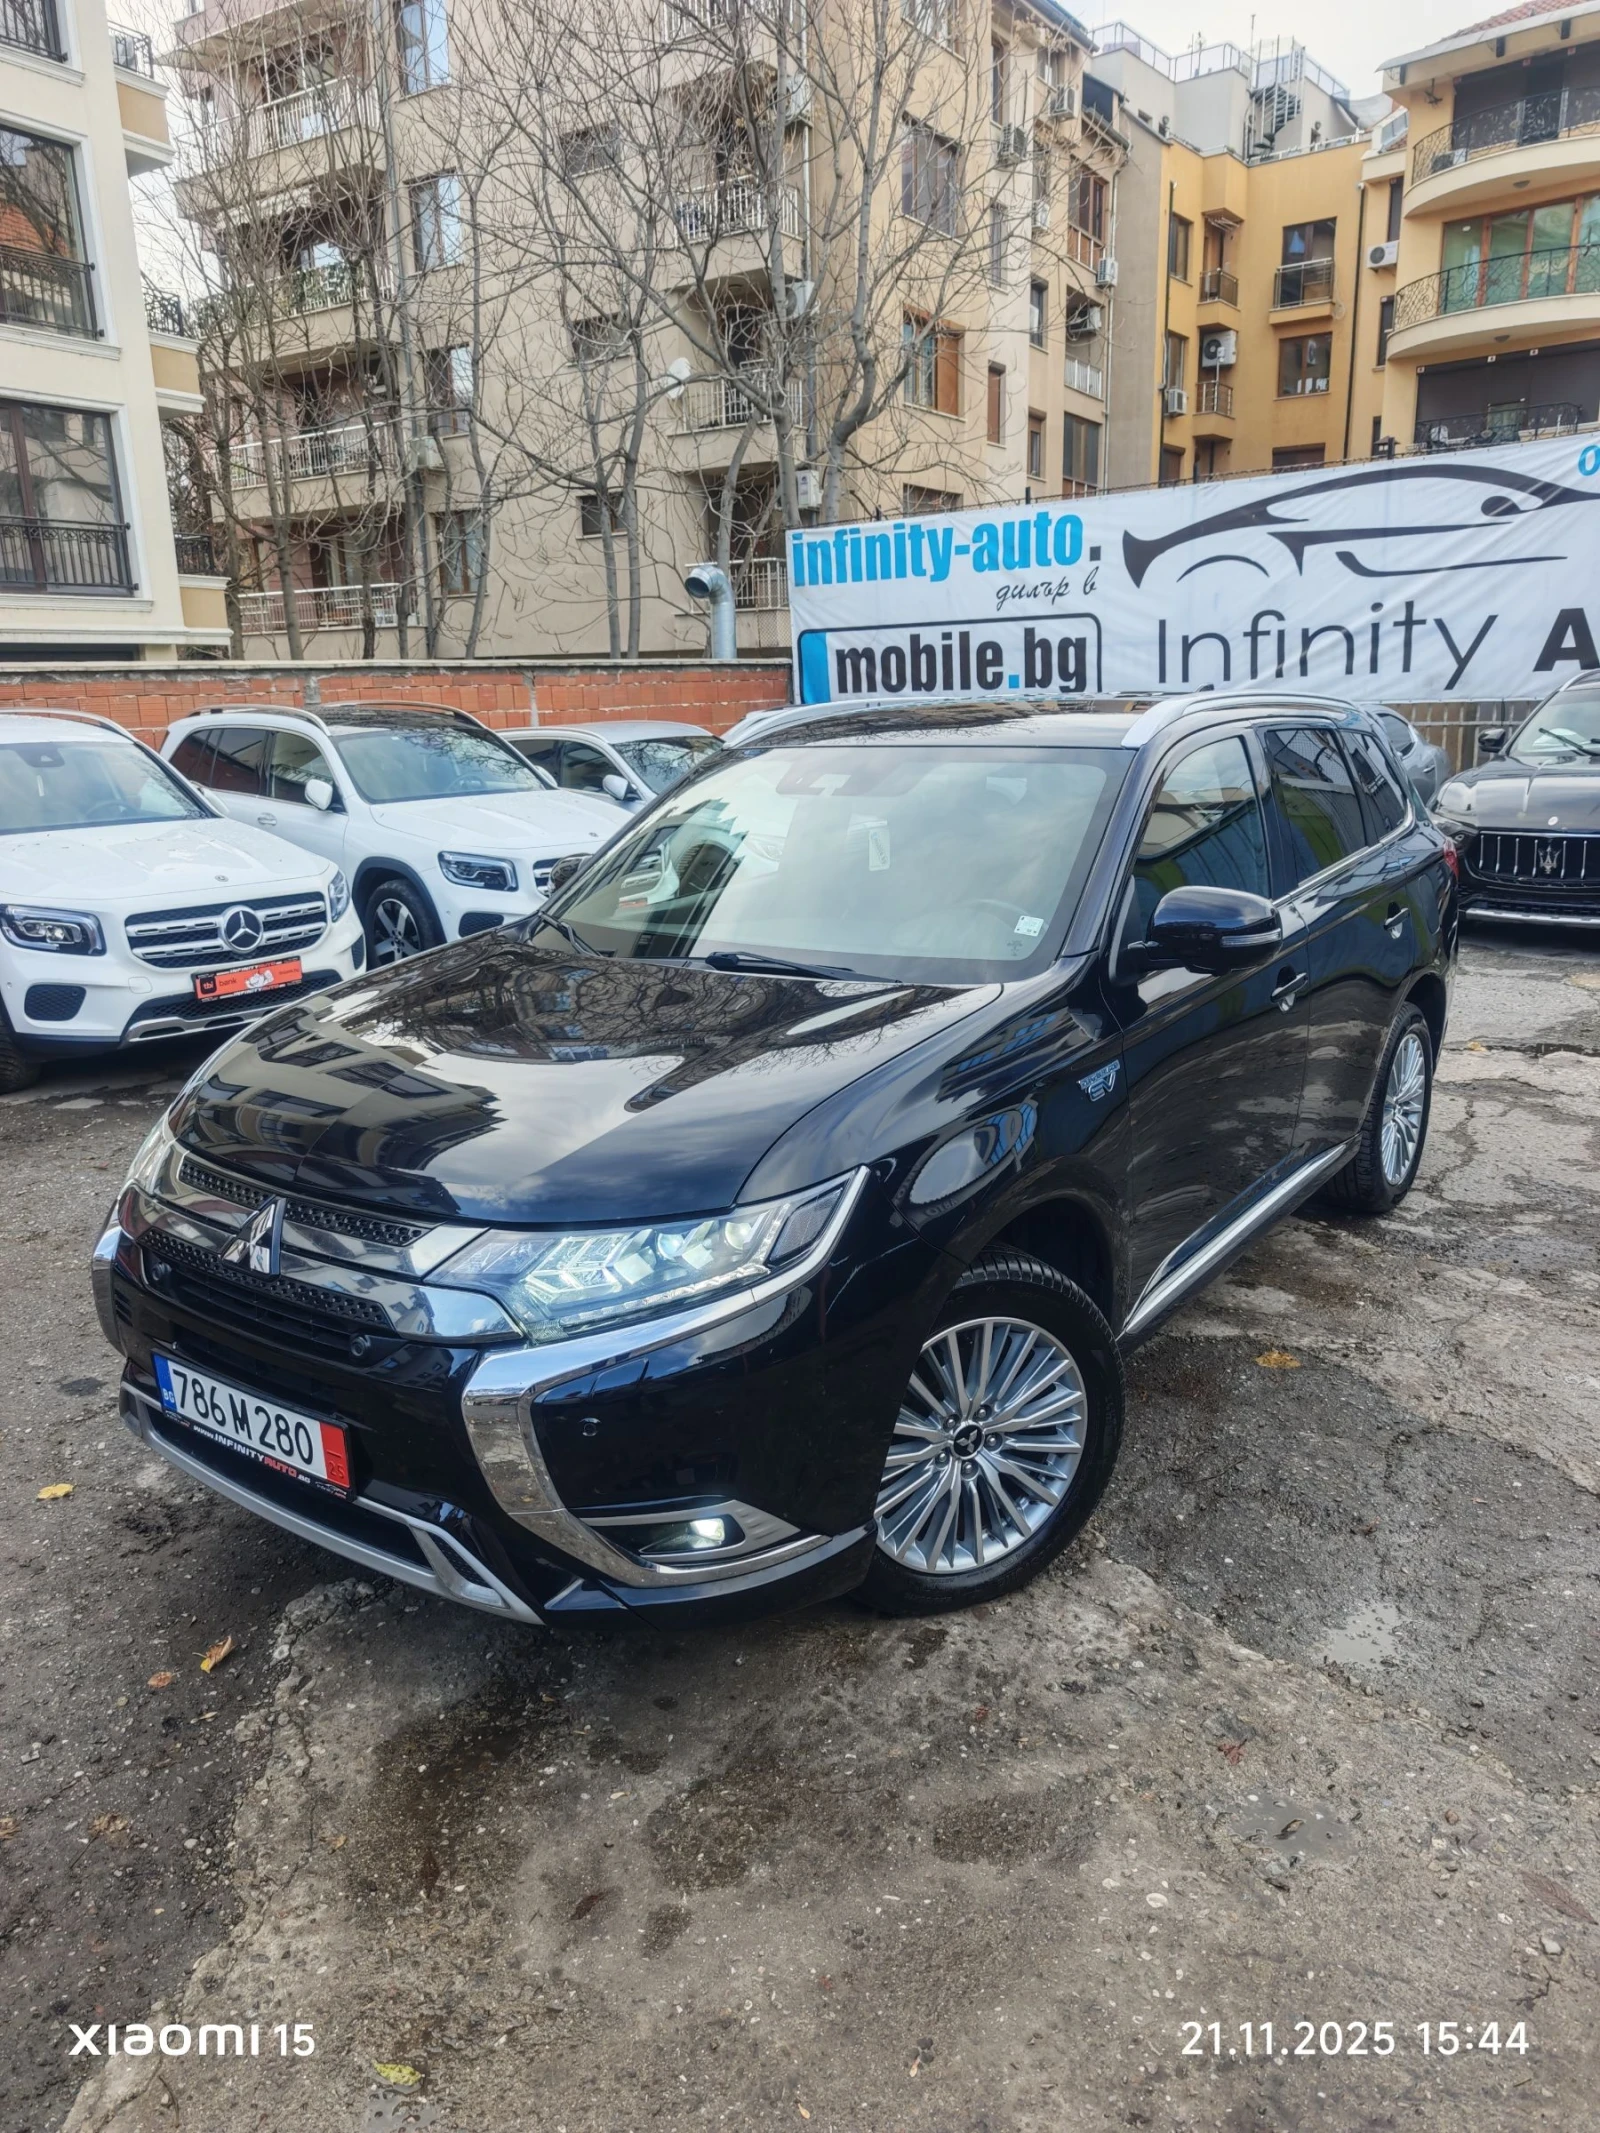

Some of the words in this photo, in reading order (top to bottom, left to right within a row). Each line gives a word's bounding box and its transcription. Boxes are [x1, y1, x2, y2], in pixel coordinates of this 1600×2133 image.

[996, 576, 1070, 611] дилър
[1083, 566, 1097, 595] в
[836, 627, 1087, 693] mobile.bg
[1158, 600, 1498, 691] Infinity
[162, 1387, 175, 1404] BG
